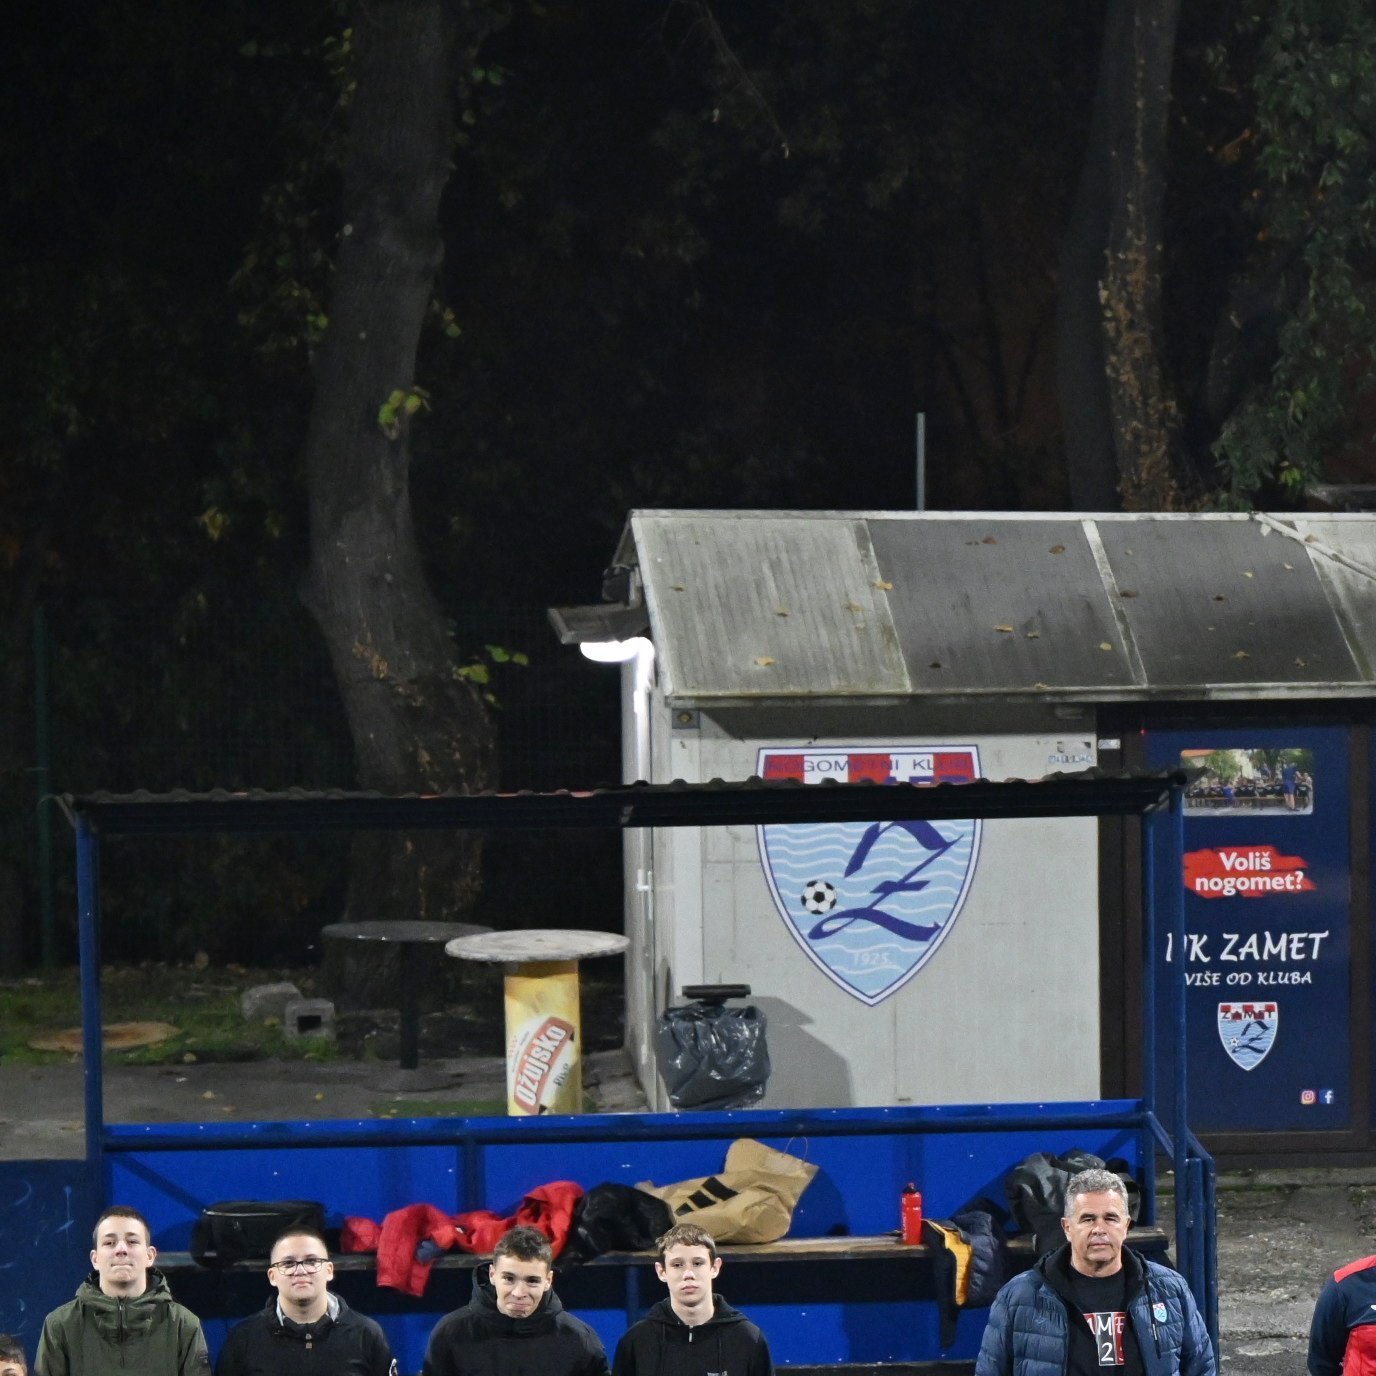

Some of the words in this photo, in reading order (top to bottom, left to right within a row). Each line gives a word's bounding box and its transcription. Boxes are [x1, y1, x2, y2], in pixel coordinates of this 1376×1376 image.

[1219, 851, 1272, 871] Voliš
[1195, 870, 1304, 896] nogomet?
[1220, 930, 1329, 962] ZAMET
[1184, 969, 1221, 986] VIŠE
[1226, 971, 1252, 986] OD
[1257, 970, 1312, 985] KLUBA
